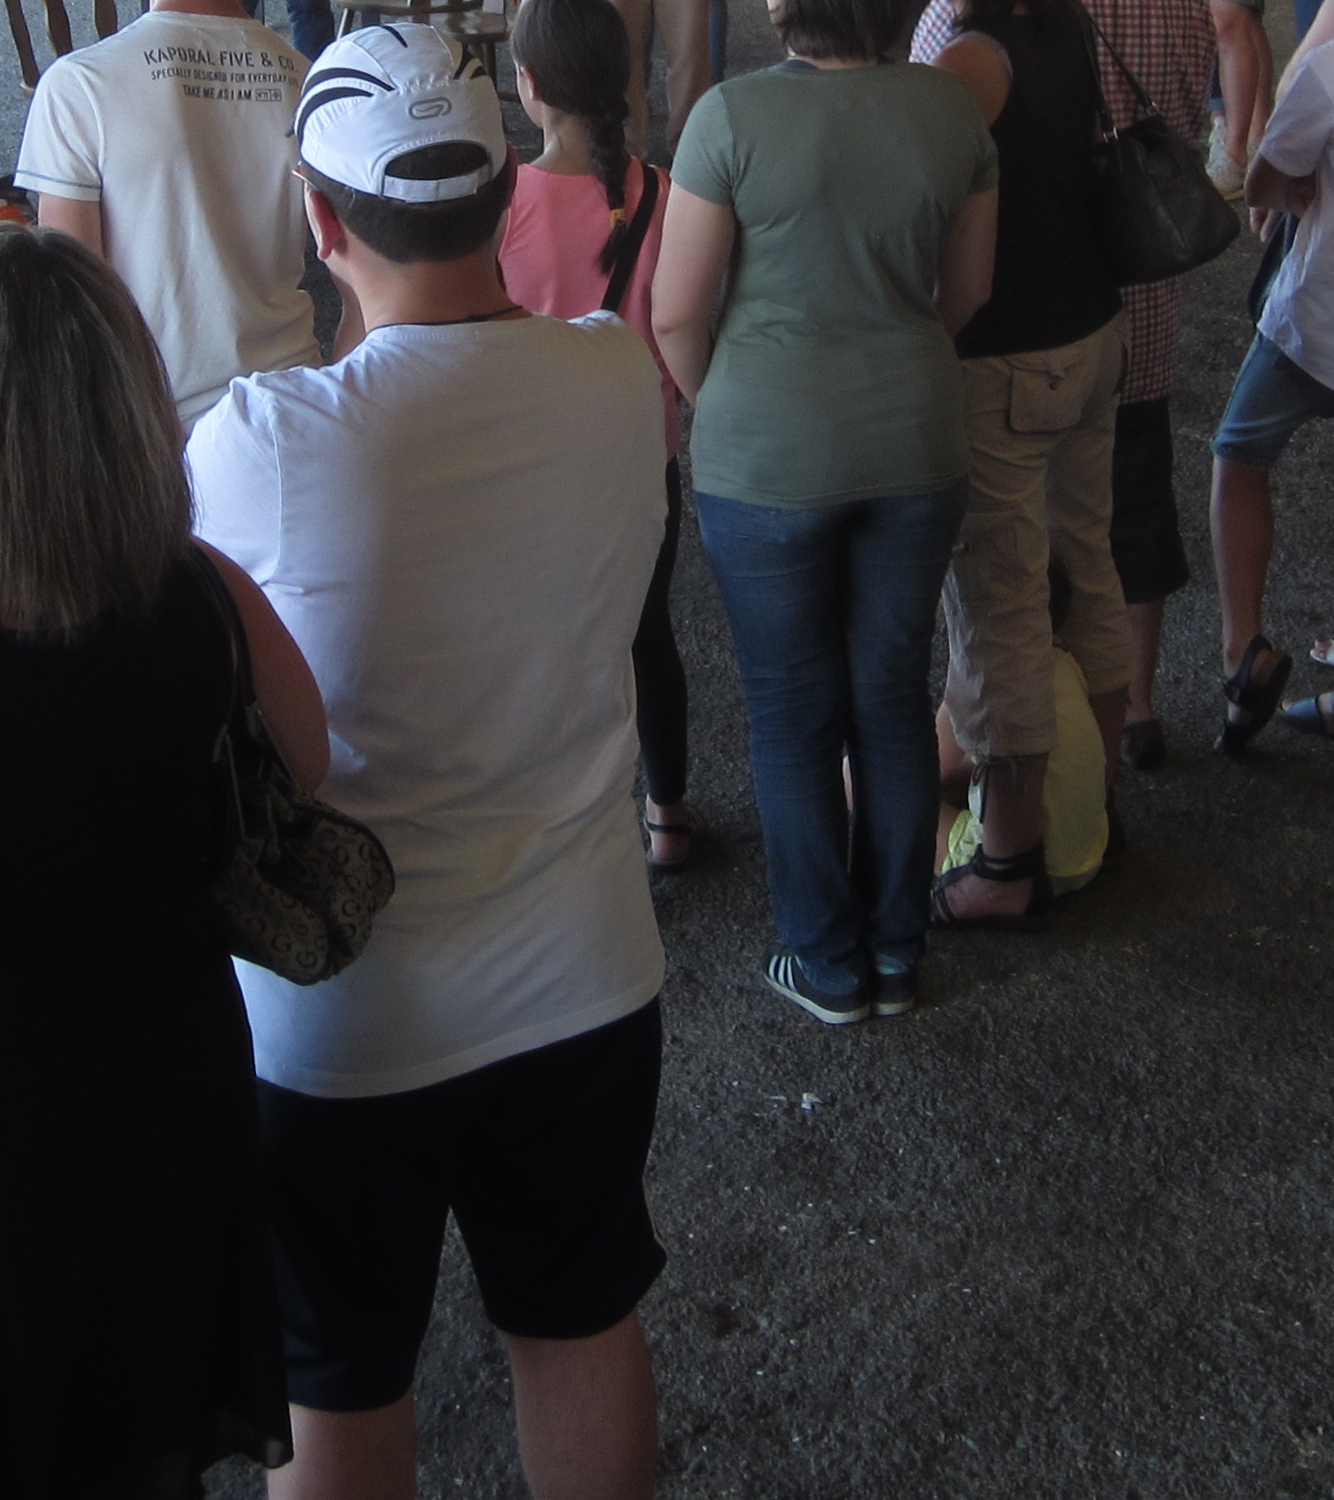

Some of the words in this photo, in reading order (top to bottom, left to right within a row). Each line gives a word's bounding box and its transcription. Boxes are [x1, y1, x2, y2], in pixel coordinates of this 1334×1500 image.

[143, 46, 216, 66] KAPORAL
[220, 50, 255, 68] FIVE
[260, 52, 273, 68] &
[151, 67, 192, 81] SPECIALLY
[193, 70, 227, 83] DESIGNED
[230, 72, 246, 83] FOR
[248, 72, 287, 84] EVERYDAY
[182, 84, 202, 99] TAKE
[203, 87, 215, 99] ME
[217, 88, 229, 100] AS
[237, 89, 252, 101] AM
